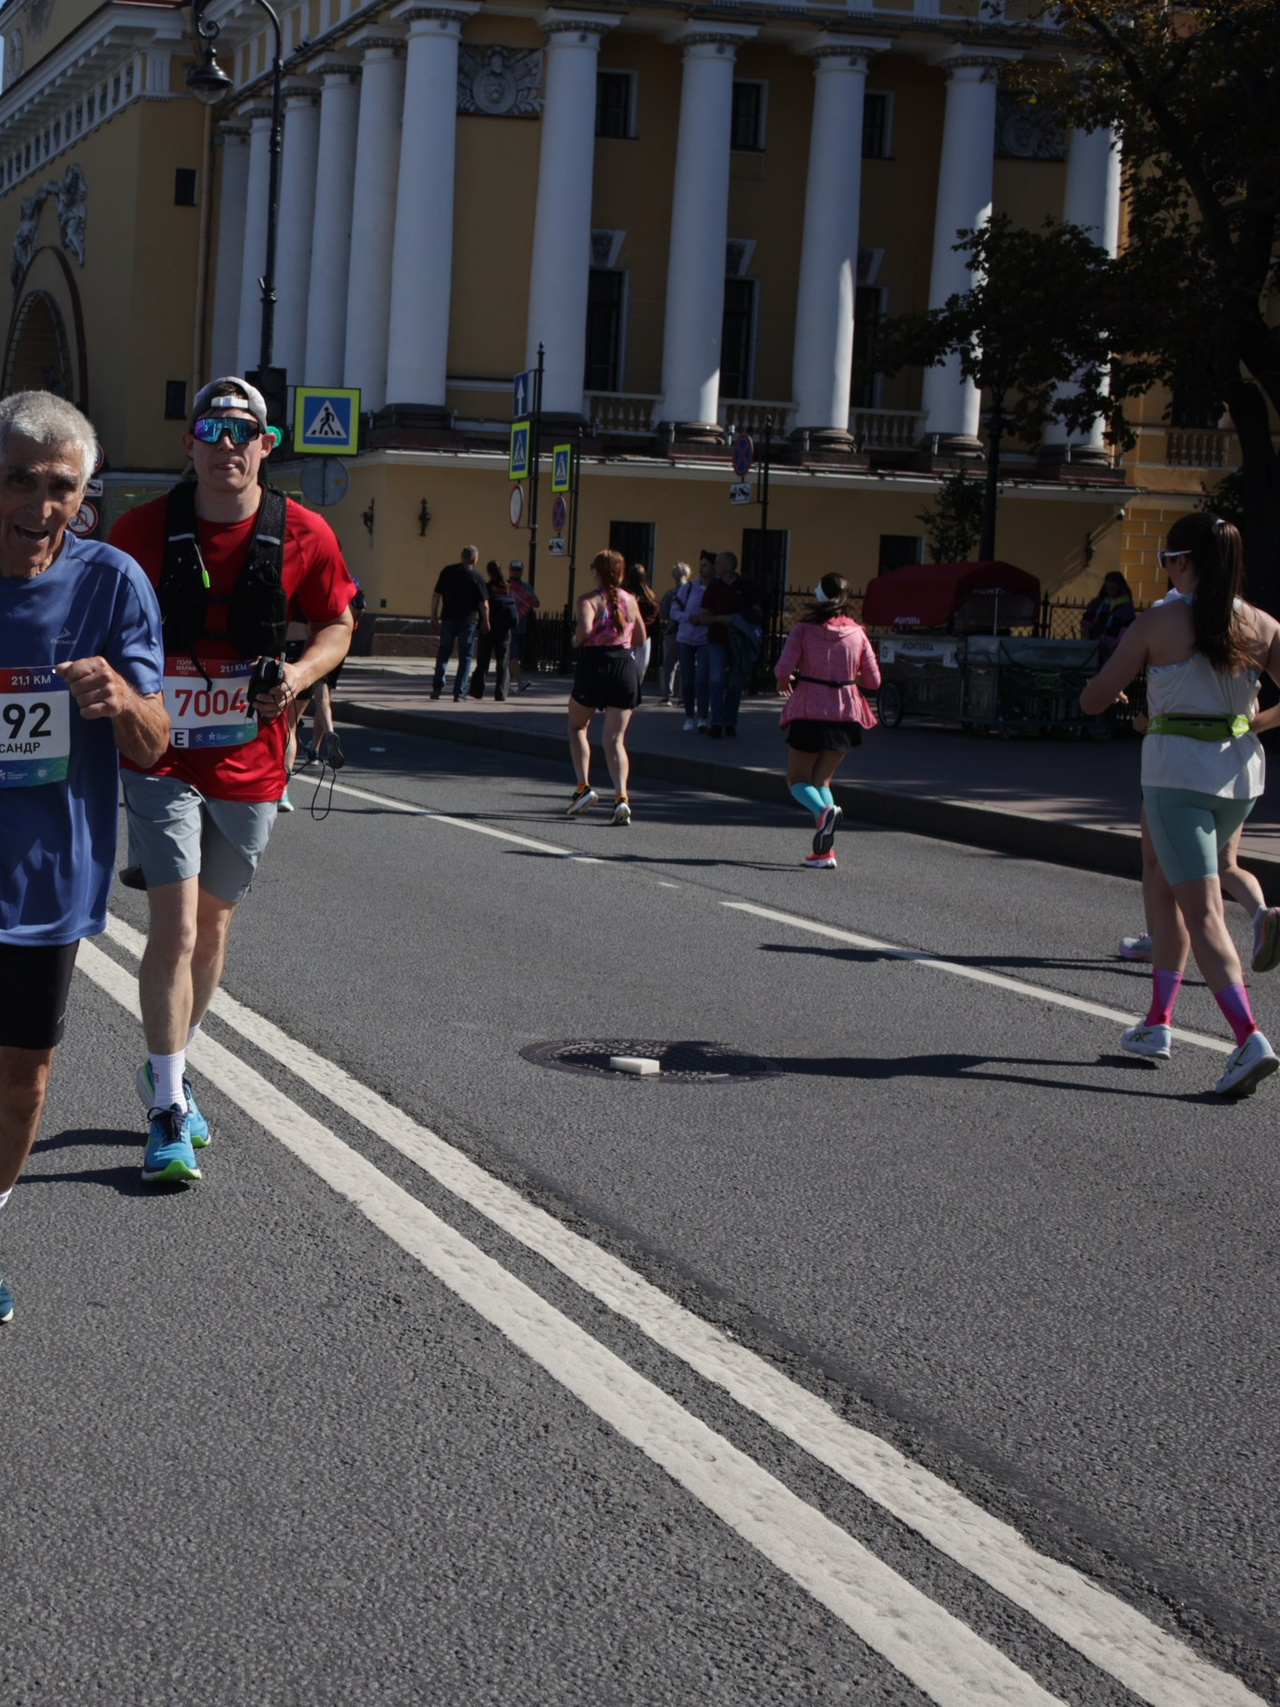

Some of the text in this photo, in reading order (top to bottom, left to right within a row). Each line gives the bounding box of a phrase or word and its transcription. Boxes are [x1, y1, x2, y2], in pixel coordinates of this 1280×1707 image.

[901, 641, 934, 652] MONTERRA
[11, 674, 51, 686] 21,1 КМ
[175, 688, 246, 717] 7004
[174, 731, 185, 746] E
